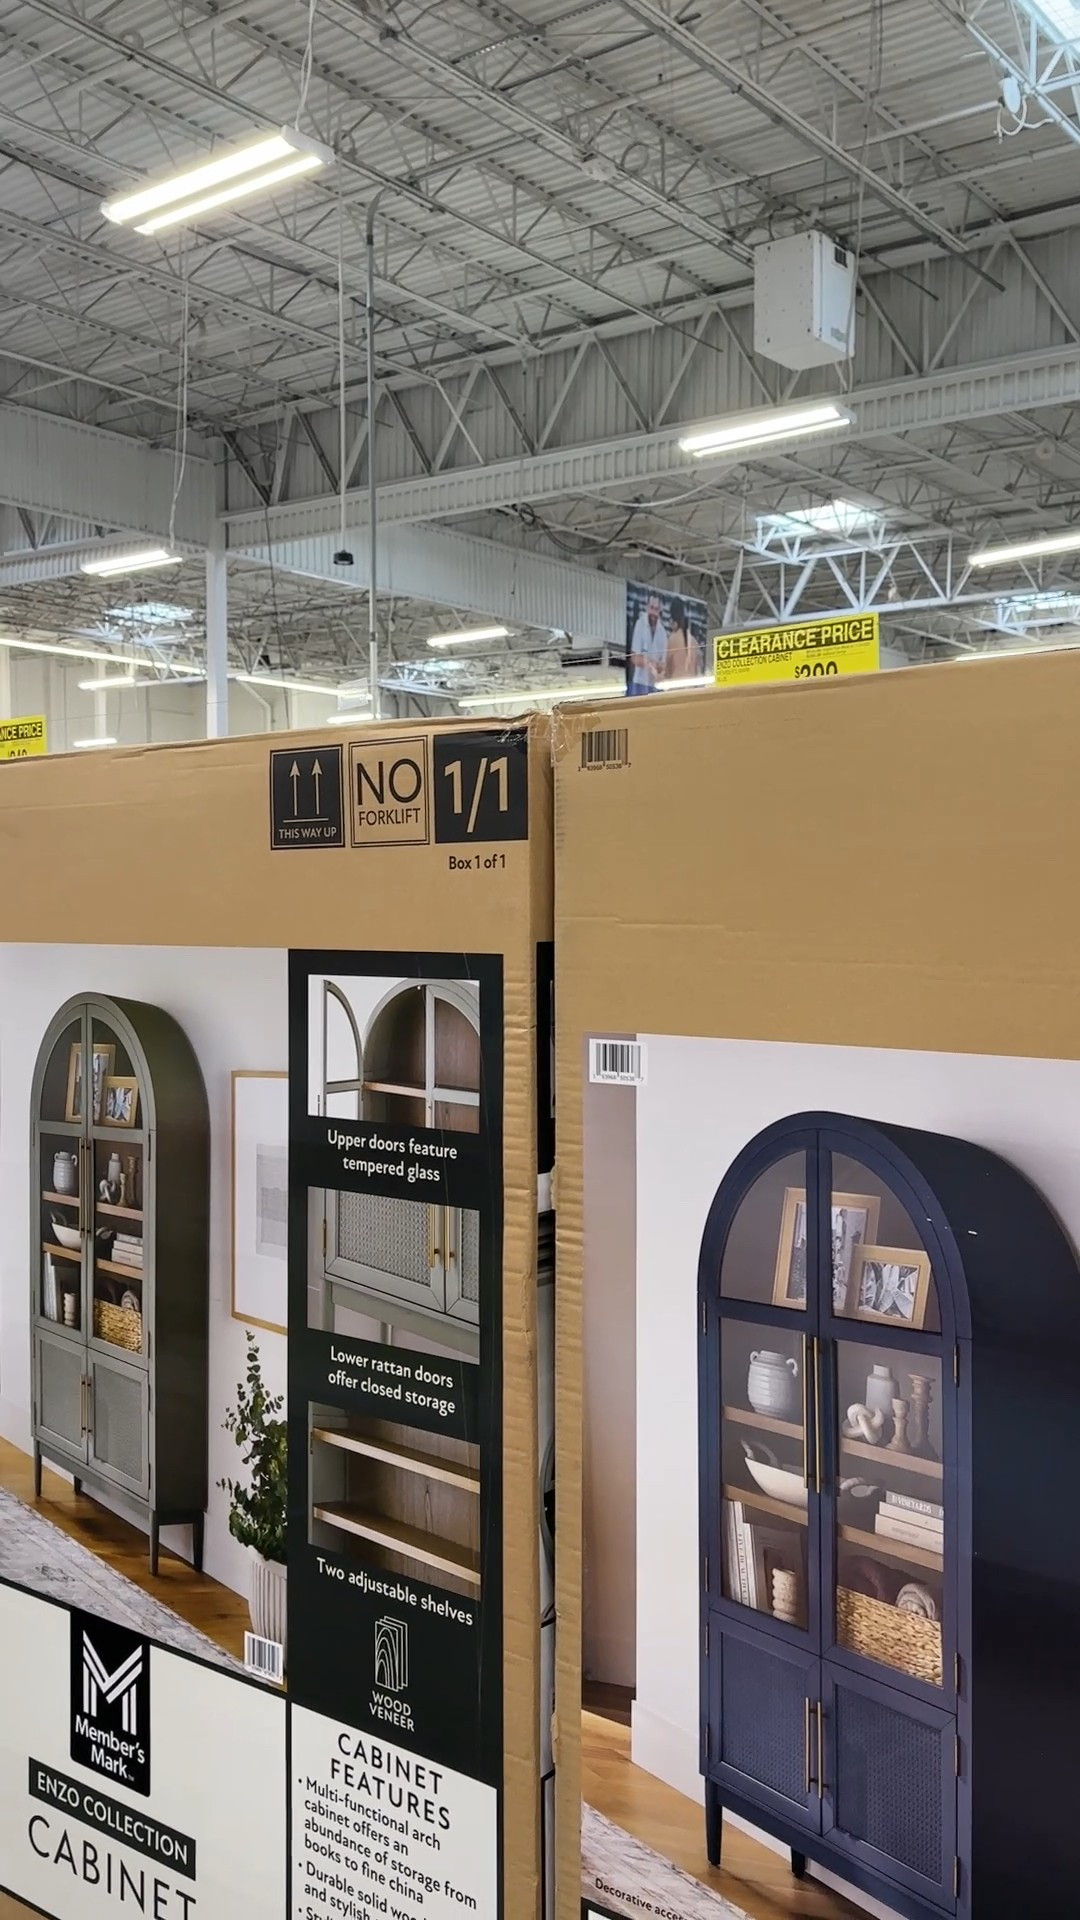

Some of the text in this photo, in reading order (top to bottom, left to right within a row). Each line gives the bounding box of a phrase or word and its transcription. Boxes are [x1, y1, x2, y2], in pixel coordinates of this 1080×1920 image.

[717, 652, 792, 669] ENZO COLLECTION CABINET
[718, 628, 821, 659] CLEARANCE
[821, 620, 873, 645] PRICE
[19, 724, 41, 737] PRICE
[356, 757, 422, 806] NO
[444, 756, 509, 834] 1/1
[278, 827, 337, 839] THIS WAY UP
[358, 808, 421, 826] FORKLIFT
[449, 854, 505, 870] Box 1 of 1
[327, 1129, 457, 1159] Upper doors feature
[343, 1157, 441, 1183] tempered glass
[331, 1346, 454, 1388] Lower rattan doors
[328, 1370, 456, 1416] offer closed storage
[316, 1557, 473, 1626] Two adjustable shelves
[369, 1702, 414, 1732] VENEER
[372, 1690, 411, 1716] WOOD
[75, 1714, 146, 1764] Member's
[338, 1733, 442, 1794] CABINET
[306, 1776, 440, 1850] Multi-functional arch
[330, 1758, 451, 1830] FEATURES
[38, 1771, 188, 1865] ENZO COLLECTION
[305, 1800, 408, 1855] cabinet offers an
[28, 1815, 196, 1920] CABINET
[305, 1817, 477, 1909] abundance of storage from
[305, 1834, 423, 1904] books to fine china
[304, 1884, 326, 1902] and
[330, 1896, 370, 1920] stylish
[306, 1861, 354, 1896] Durable
[357, 1890, 387, 1913] solid
[596, 1878, 652, 1911] Decorative
